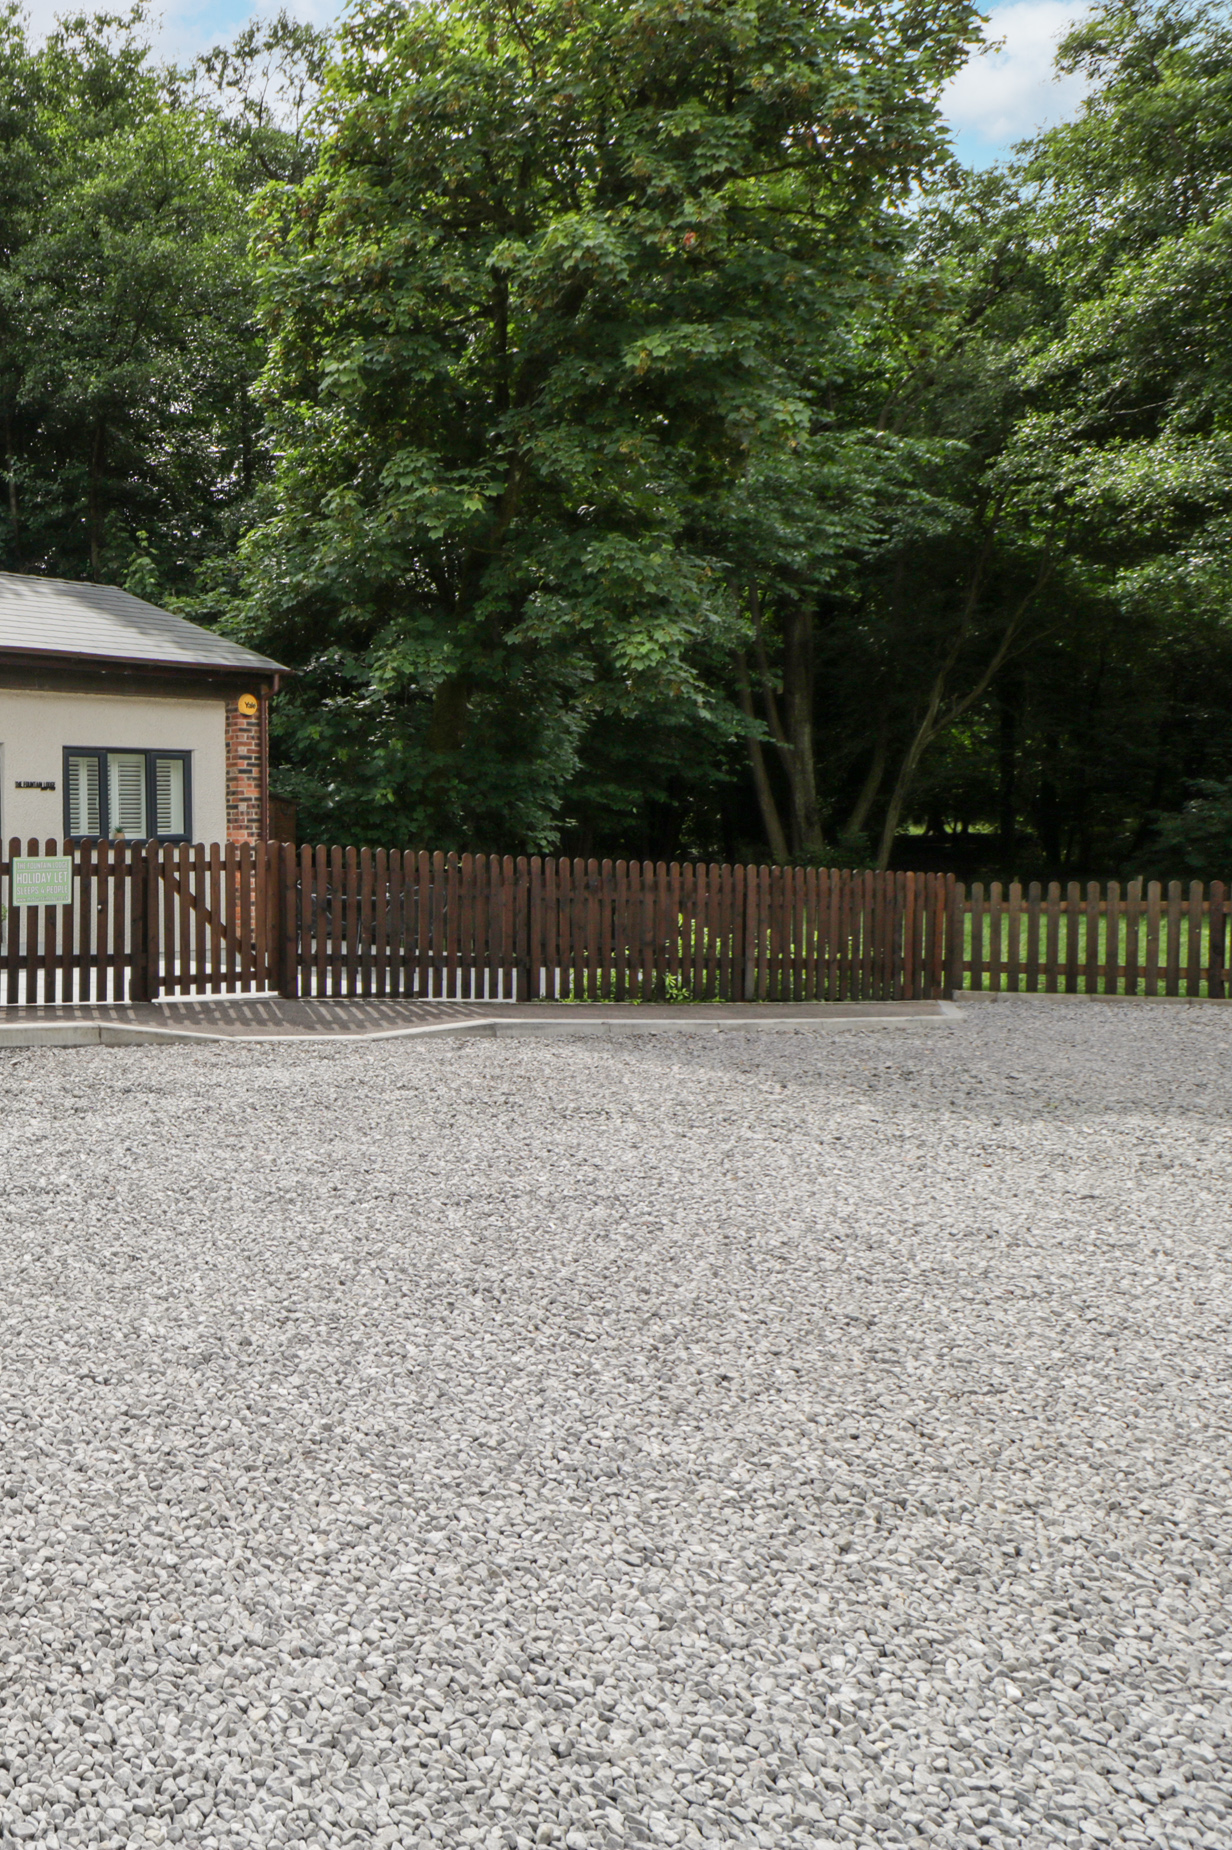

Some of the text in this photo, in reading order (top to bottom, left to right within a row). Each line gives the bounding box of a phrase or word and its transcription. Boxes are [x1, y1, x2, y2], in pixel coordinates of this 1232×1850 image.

[52, 861, 67, 869] LODGE
[16, 871, 68, 884] HOLIDAY LET
[16, 885, 68, 895] SLEEPS 4 PEOPLE
